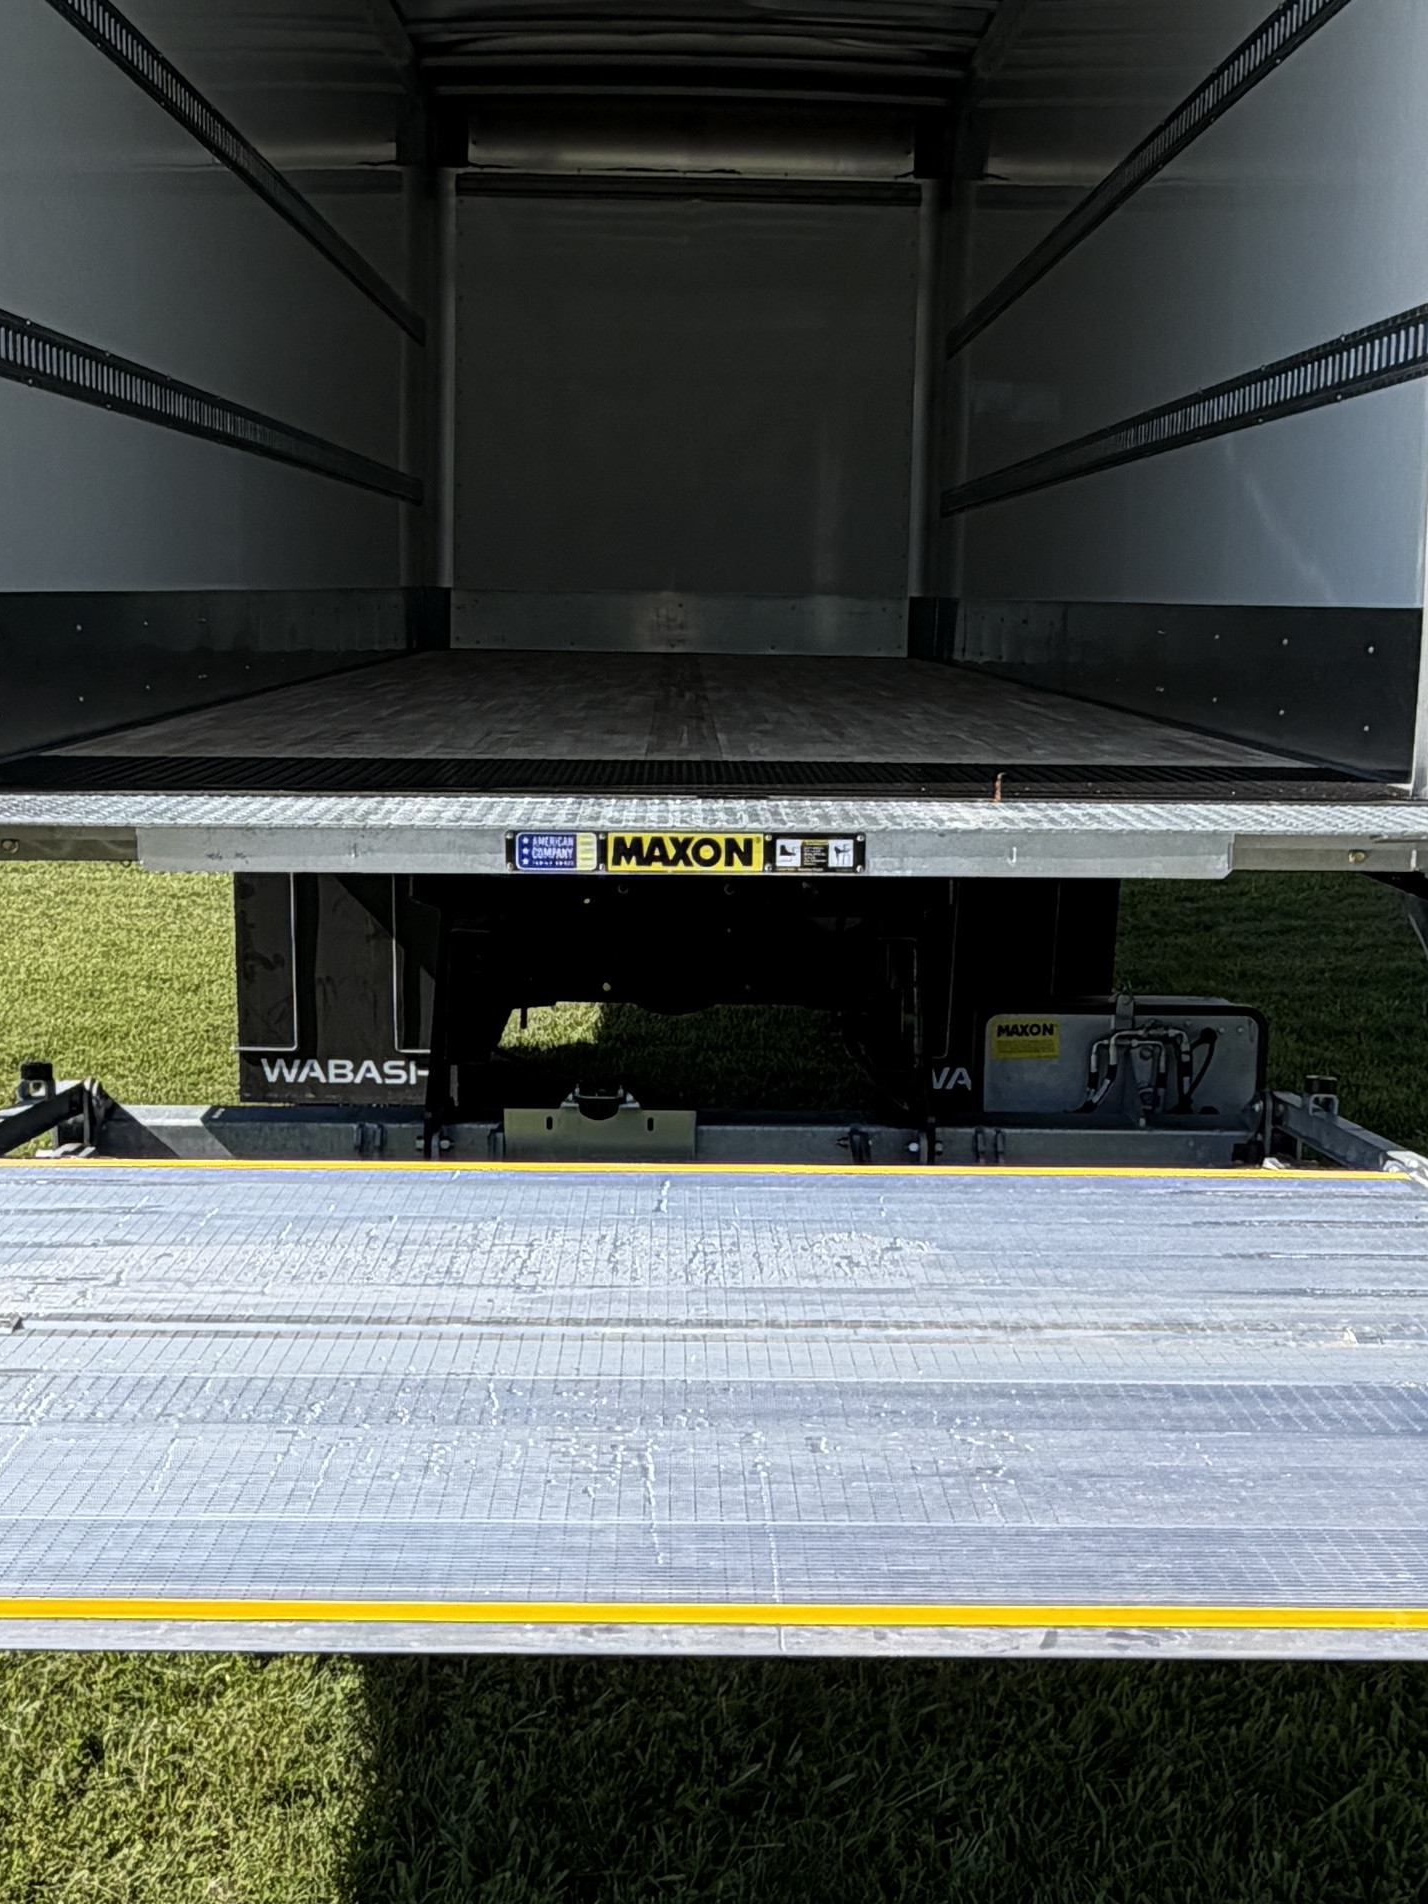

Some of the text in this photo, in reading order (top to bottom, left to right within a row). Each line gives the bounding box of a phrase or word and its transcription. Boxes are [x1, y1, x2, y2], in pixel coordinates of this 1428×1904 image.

[532, 836, 574, 847] AMERICAN
[531, 847, 574, 859] COMPANY
[611, 836, 754, 867] MAXON
[996, 1023, 1055, 1038] MAXON
